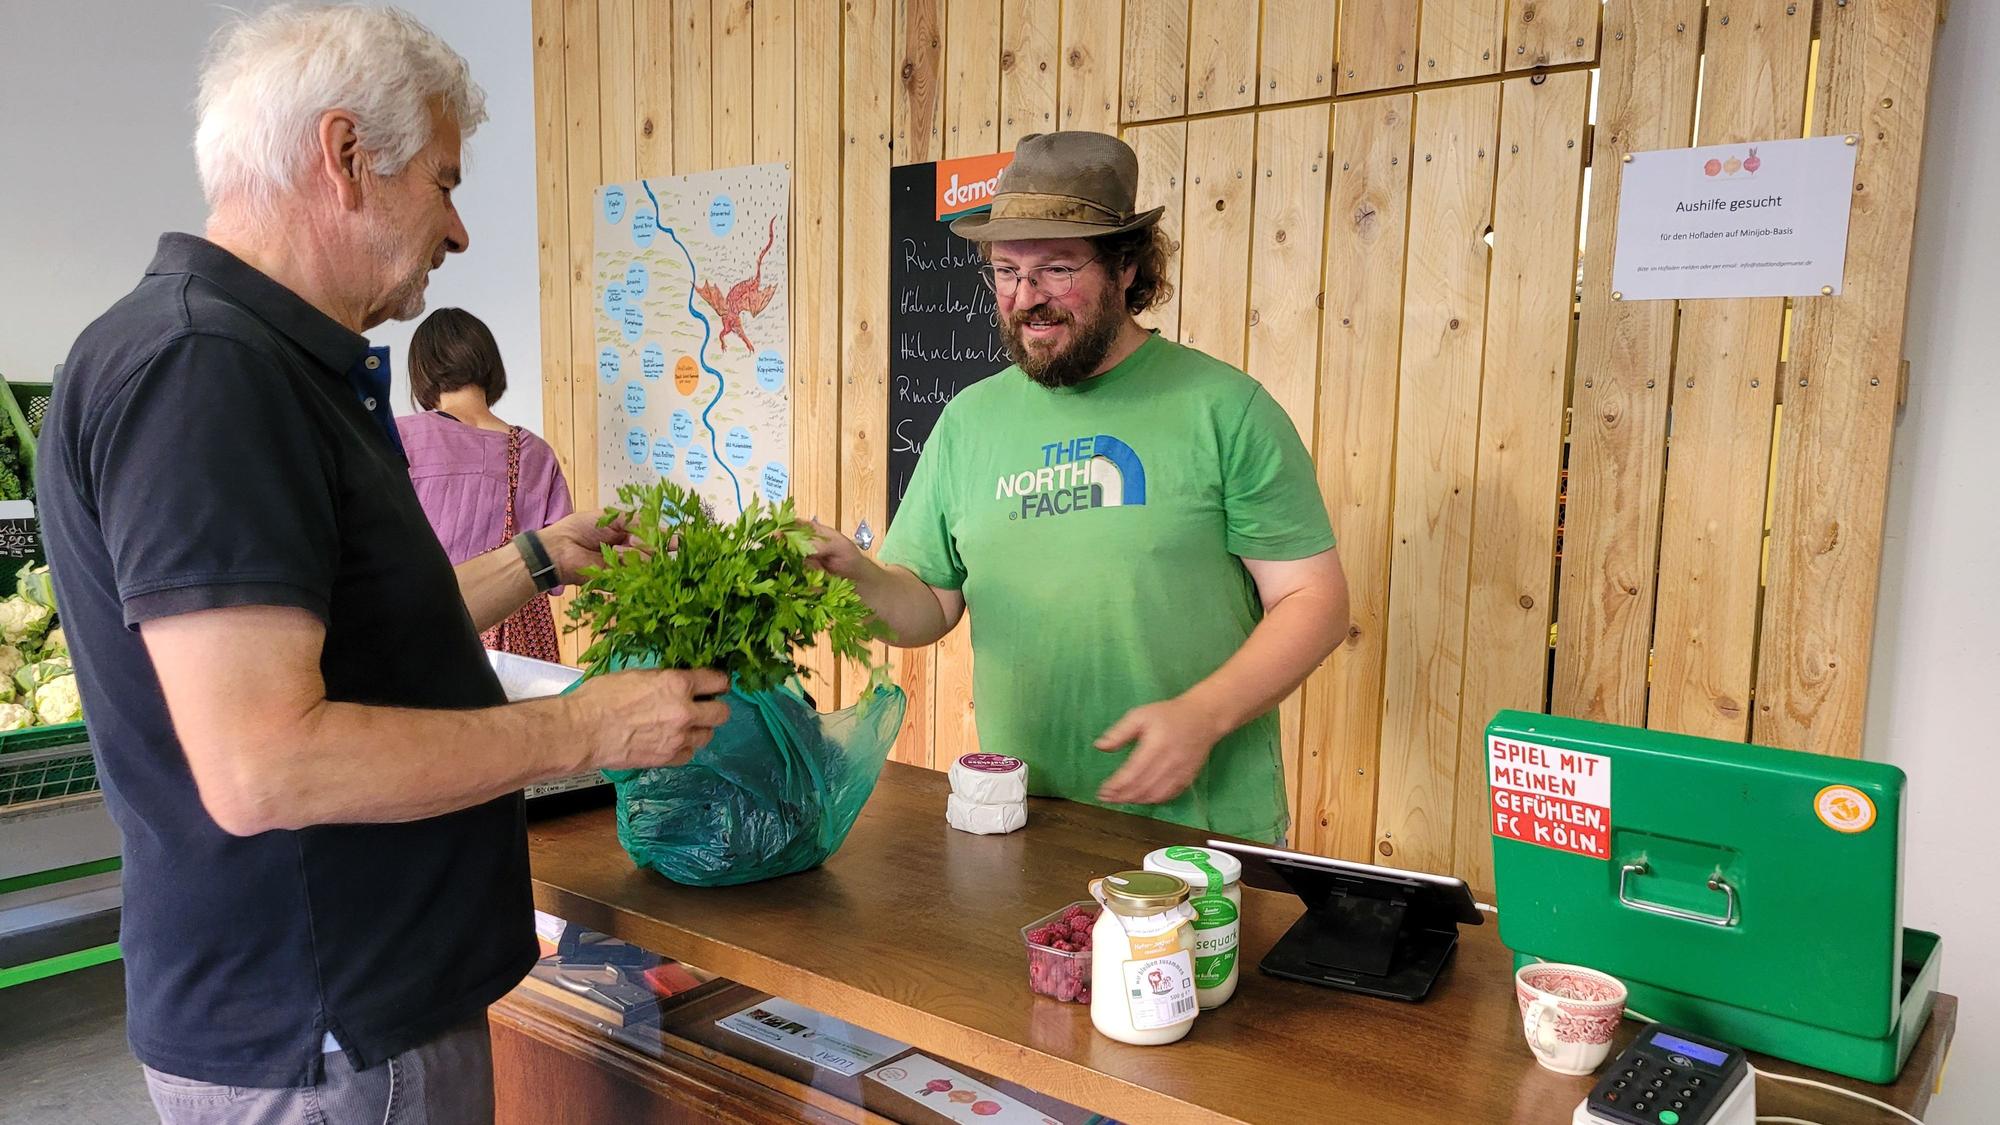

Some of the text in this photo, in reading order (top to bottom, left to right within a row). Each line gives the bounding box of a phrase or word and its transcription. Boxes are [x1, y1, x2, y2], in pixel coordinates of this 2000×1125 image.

[1676, 195, 1783, 213] Aushilfe gesucht
[1660, 227, 1793, 241] für den Hofladen auf Minijob-Basis
[1042, 437, 1093, 467] THE
[996, 460, 1091, 500] NORTH
[1022, 486, 1088, 519] FACE
[1494, 741, 1599, 776] SPIEL MIT
[1495, 765, 1576, 796] MEINEN
[1496, 812, 1520, 836] FC
